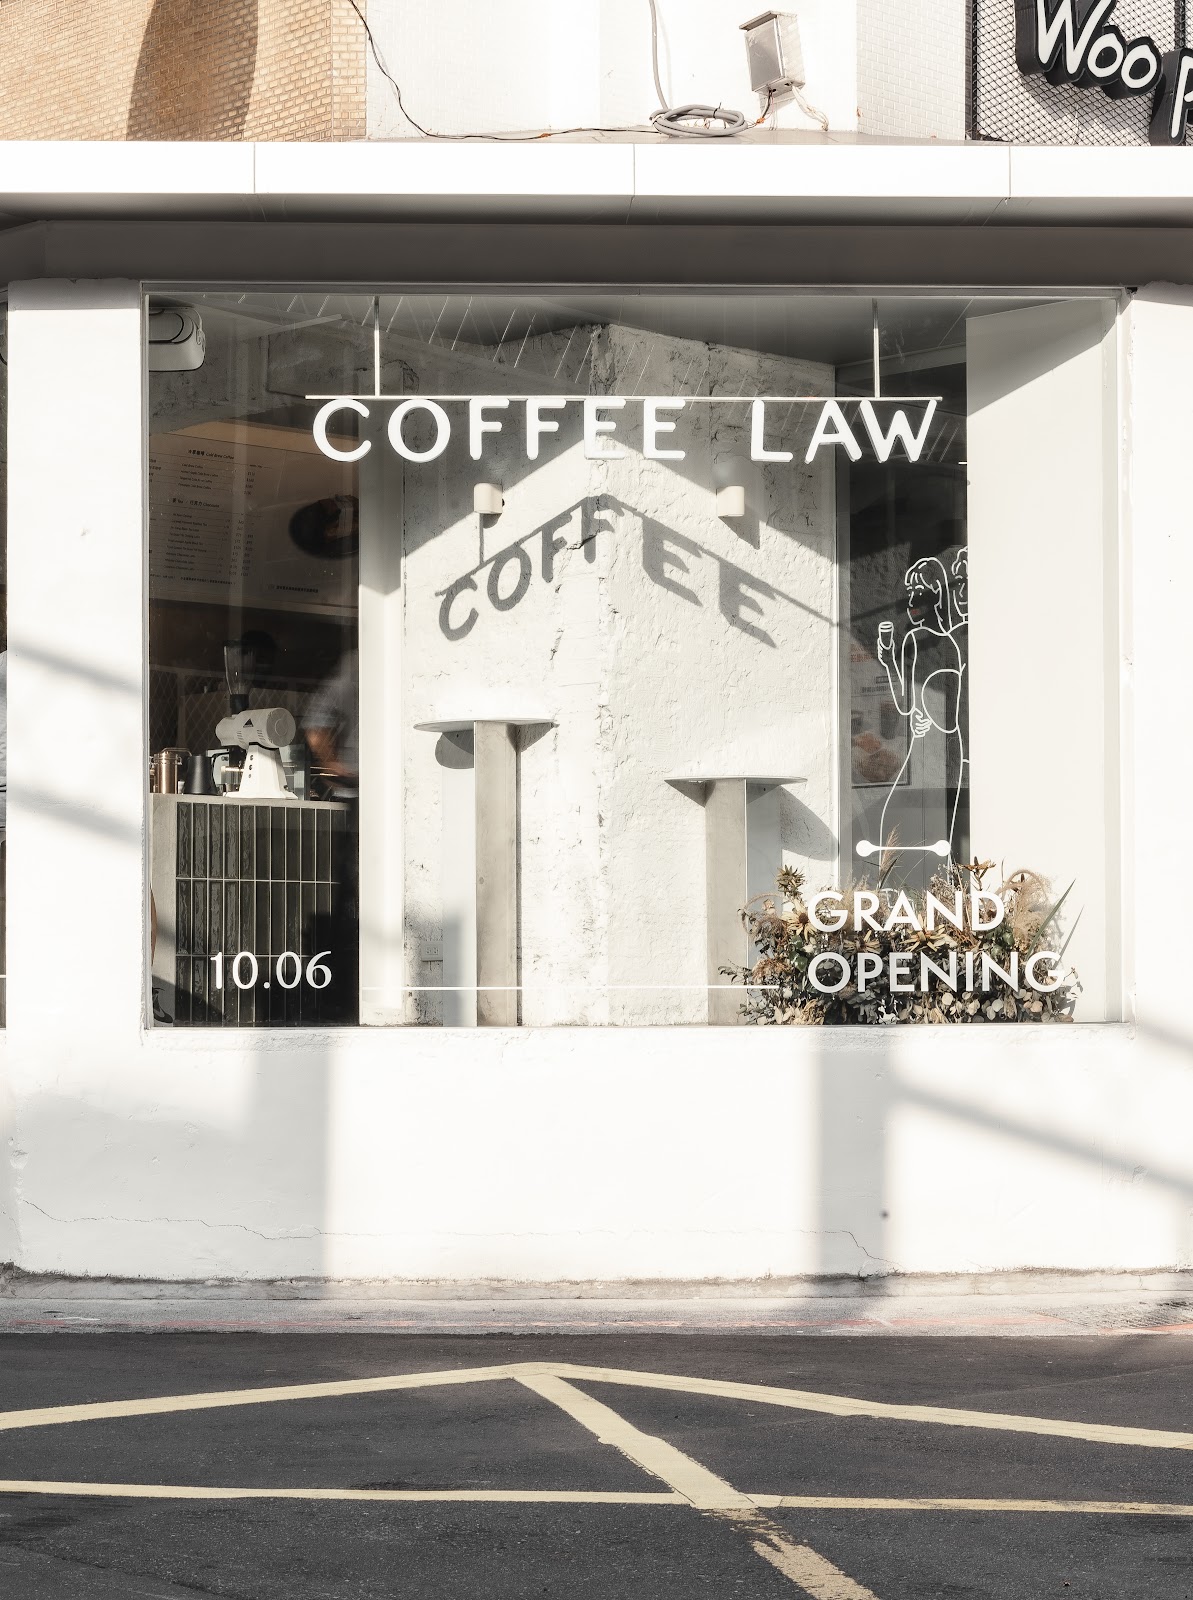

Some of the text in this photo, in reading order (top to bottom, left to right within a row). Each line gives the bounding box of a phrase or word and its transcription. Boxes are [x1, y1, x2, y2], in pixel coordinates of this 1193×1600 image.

[313, 399, 938, 465] COFFEE LAW
[438, 494, 777, 648] COFFEE
[807, 890, 1005, 933] GRAND
[210, 951, 332, 989] 10.06
[807, 950, 1065, 993] OPENING
